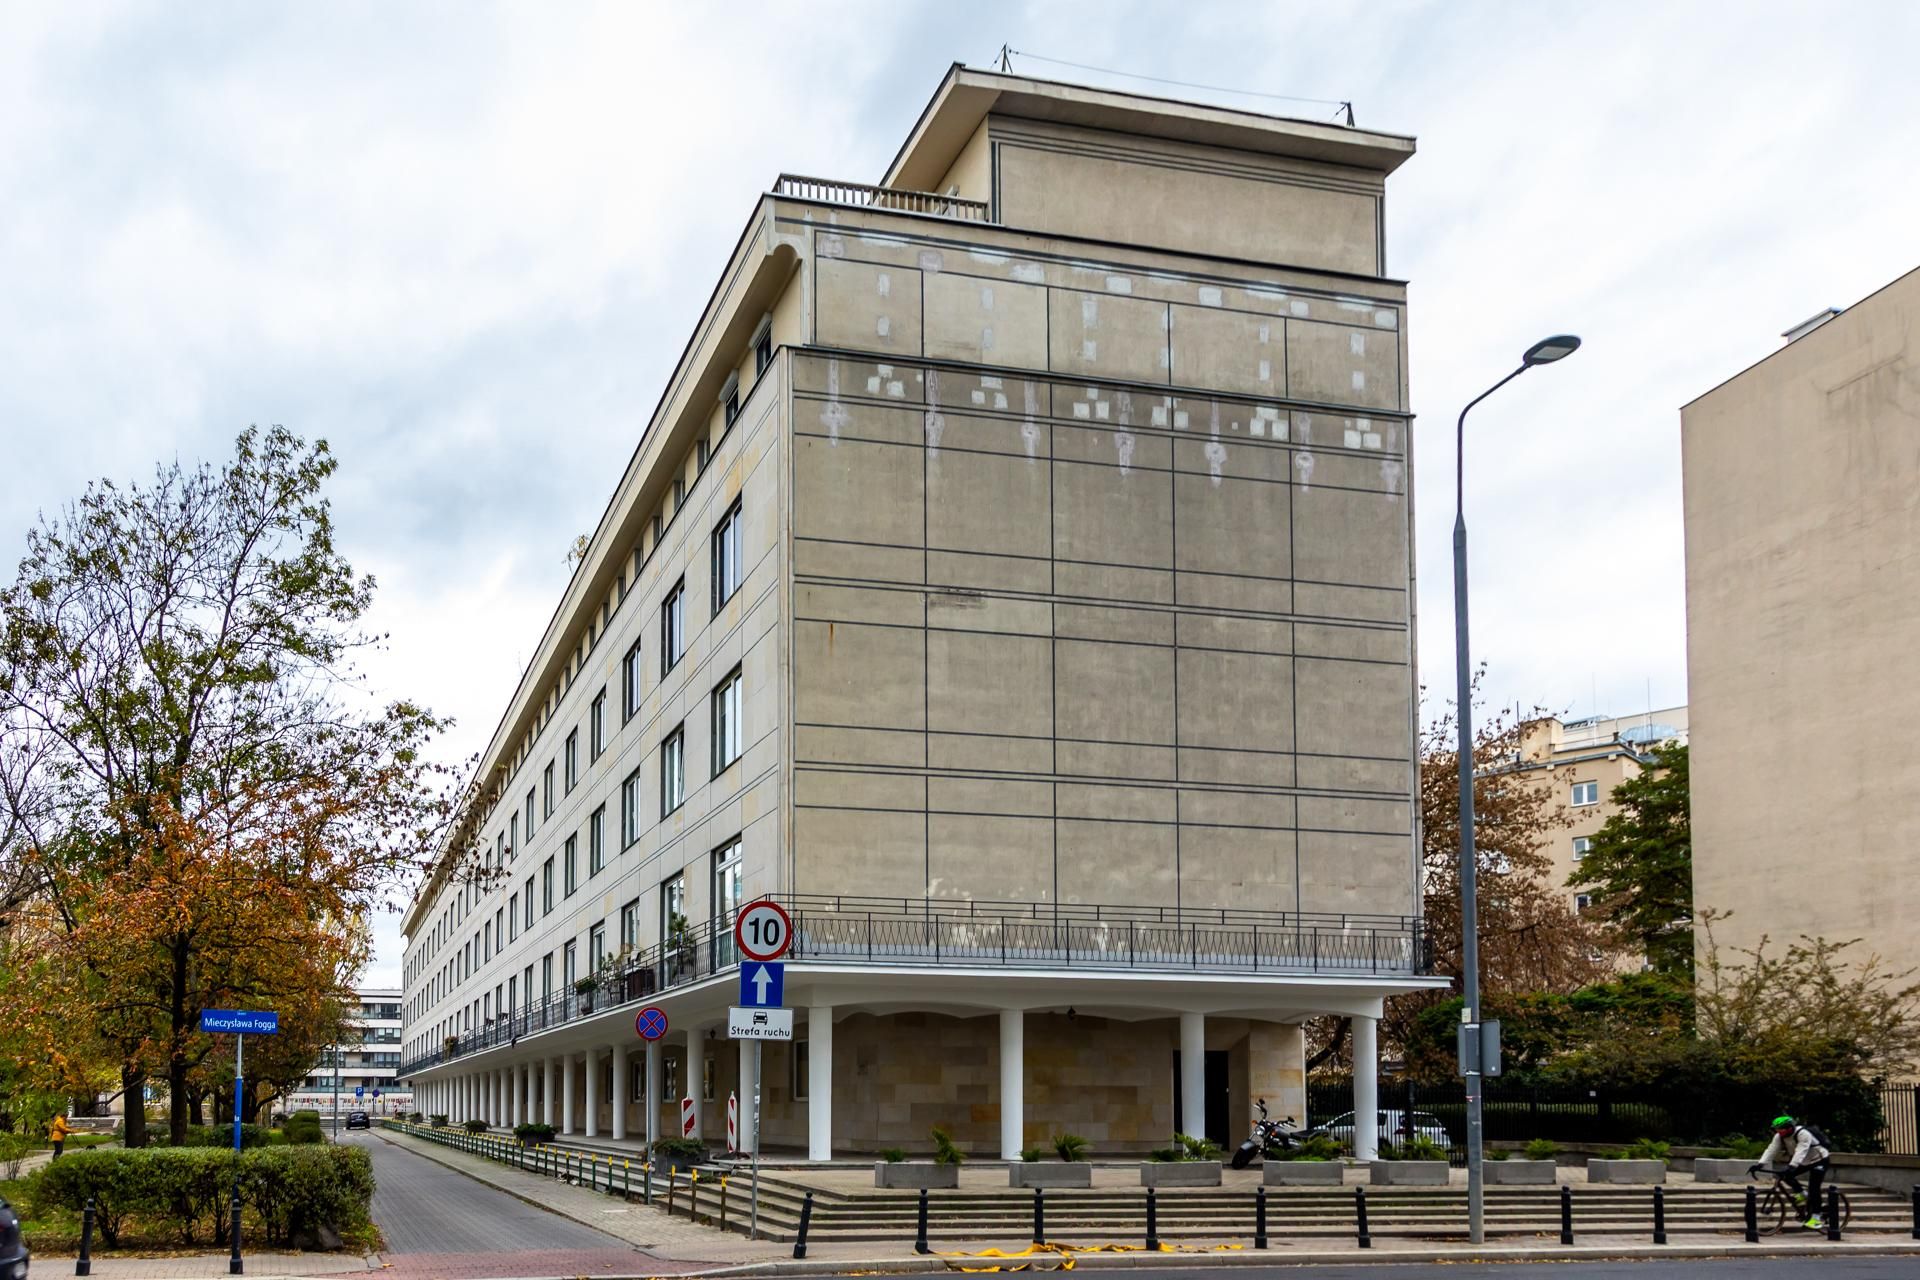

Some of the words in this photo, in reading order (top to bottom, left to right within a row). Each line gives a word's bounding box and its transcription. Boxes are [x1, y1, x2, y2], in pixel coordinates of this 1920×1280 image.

[749, 917, 780, 946] 10
[204, 1017, 253, 1029] Mieczysława
[254, 1019, 276, 1031] Fogga
[731, 1026, 760, 1036] Strefa
[764, 1027, 790, 1037] ruchu
